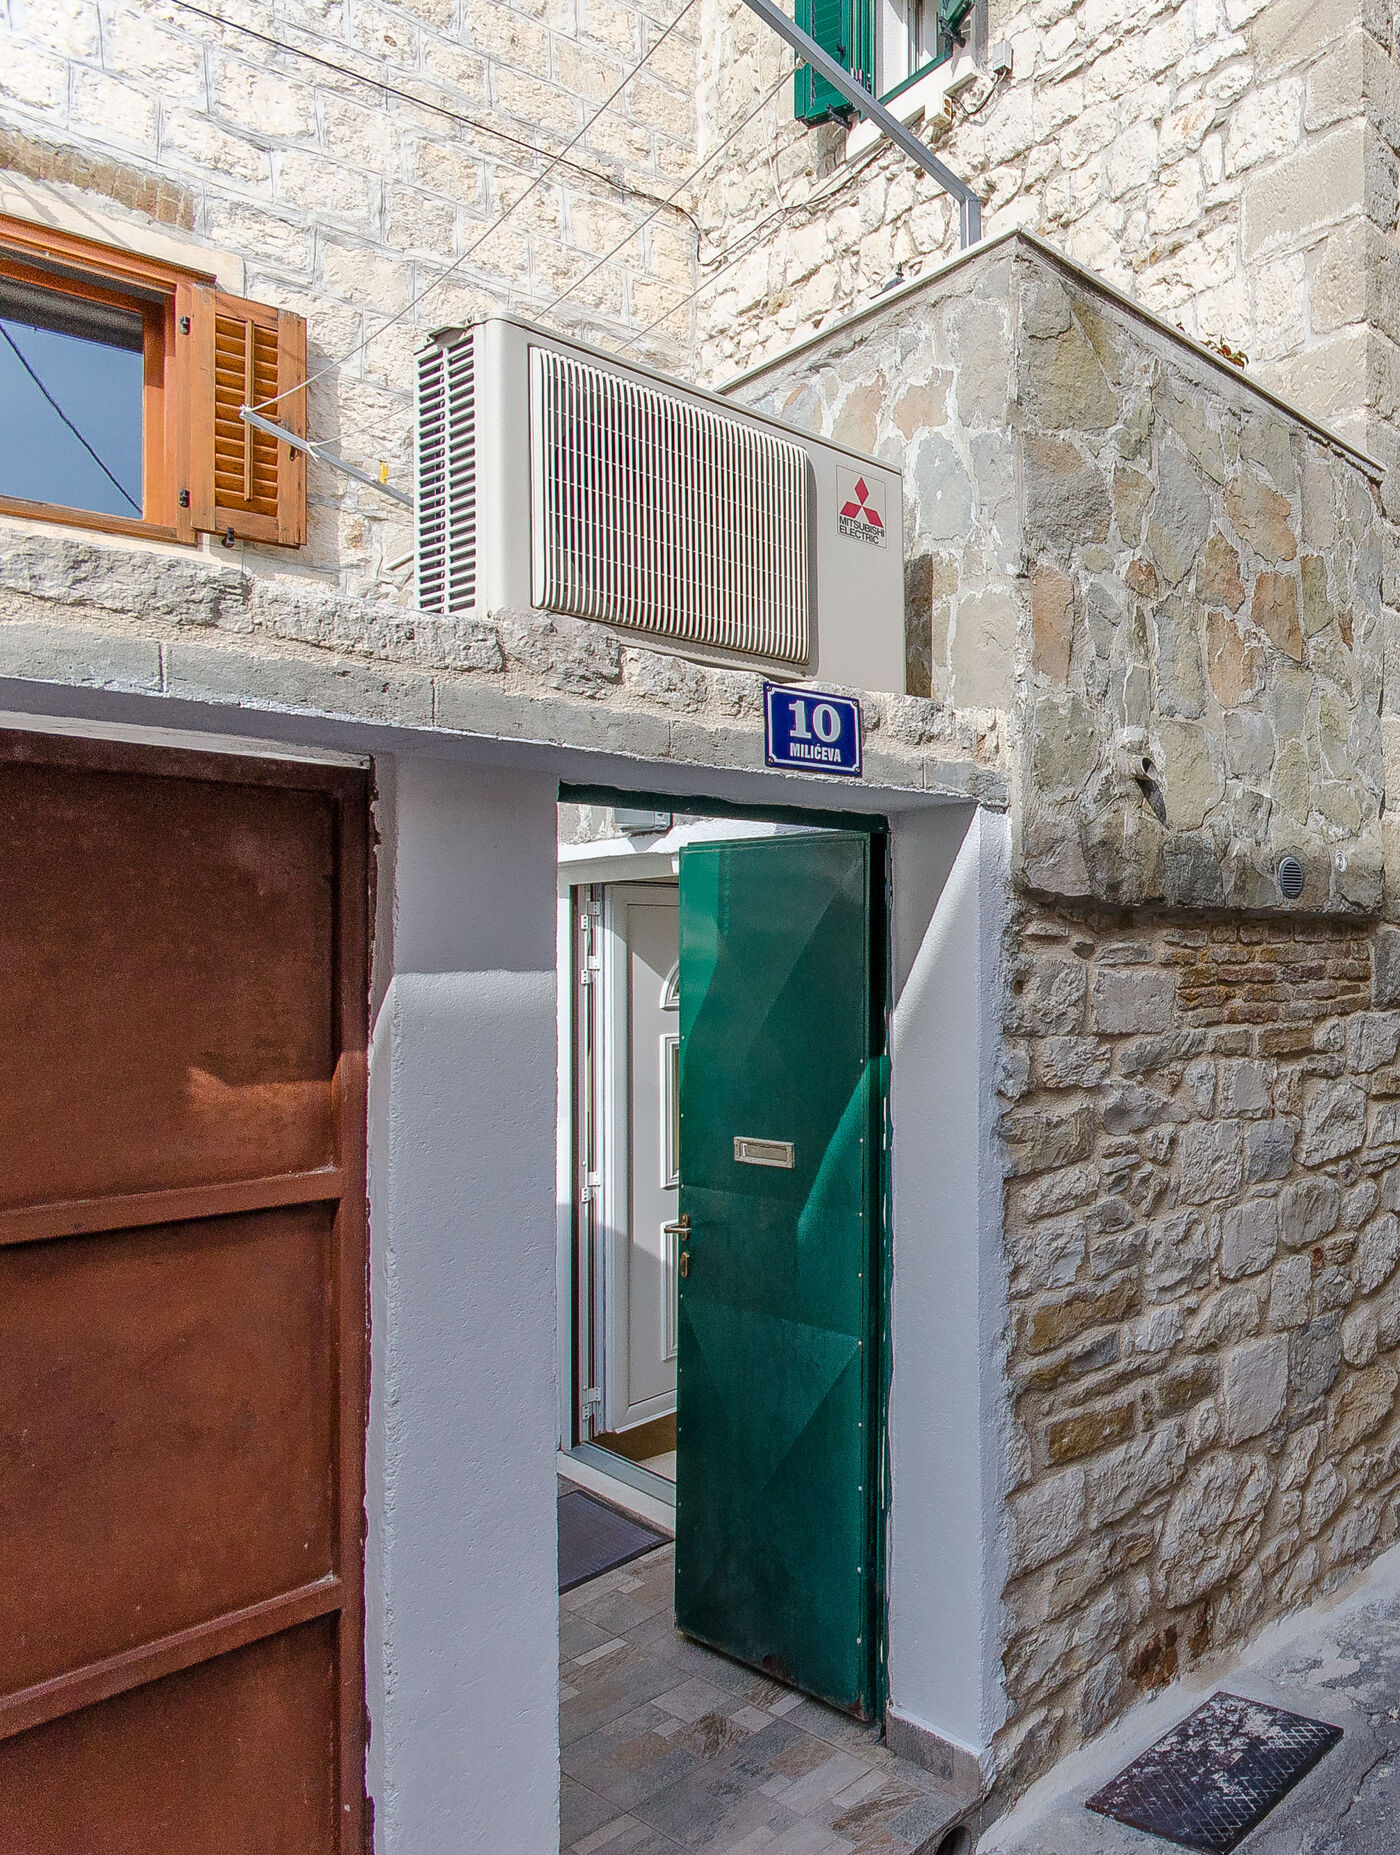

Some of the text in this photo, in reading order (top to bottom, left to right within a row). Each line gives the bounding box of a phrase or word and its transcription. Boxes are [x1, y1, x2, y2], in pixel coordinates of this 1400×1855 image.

[839, 515, 885, 537] MITSUBISHI
[839, 525, 879, 544] ELECTRIC
[788, 700, 841, 743] 10
[789, 742, 842, 763] MILIĆEVA
